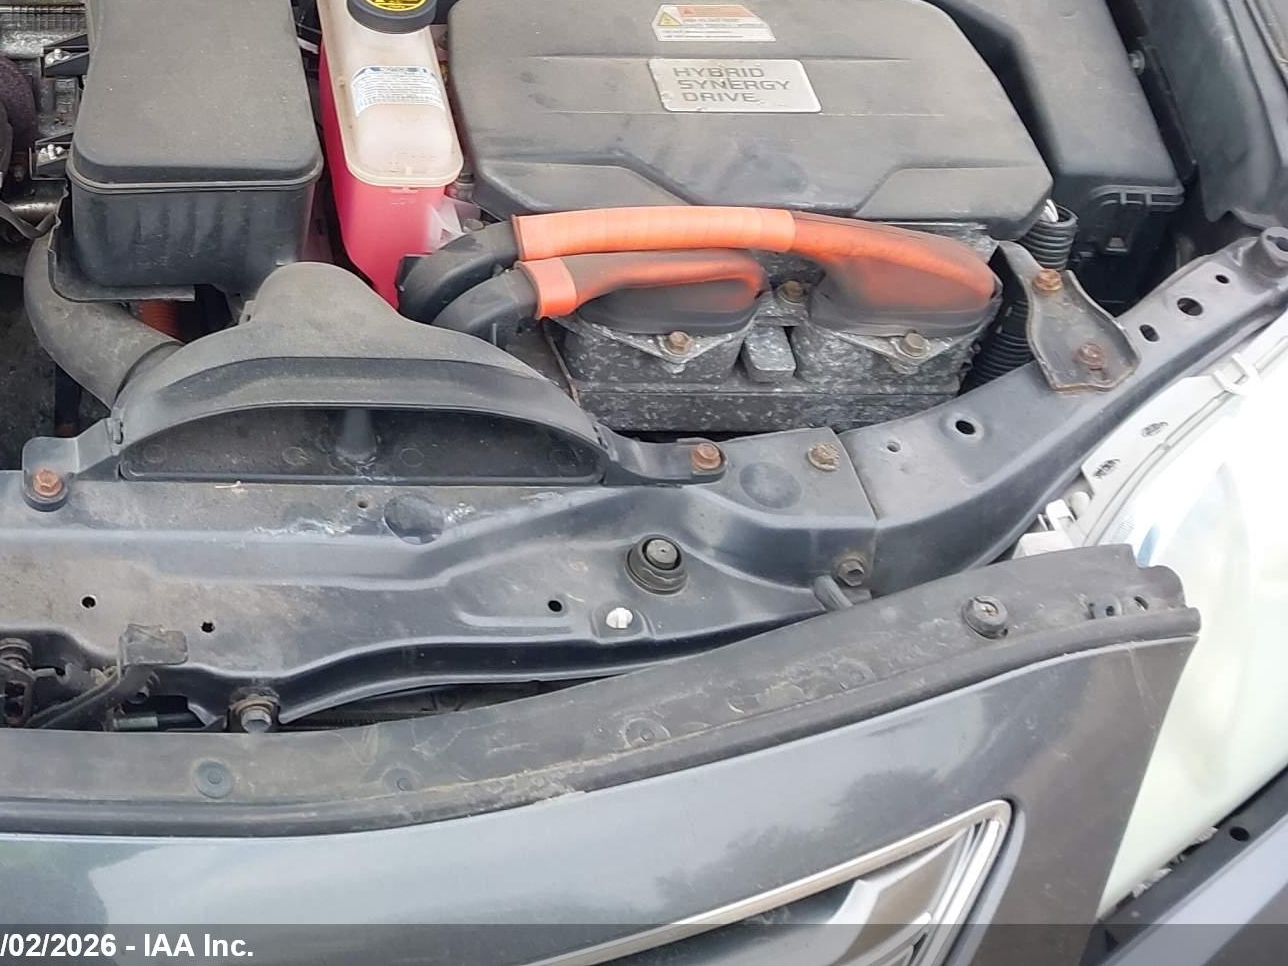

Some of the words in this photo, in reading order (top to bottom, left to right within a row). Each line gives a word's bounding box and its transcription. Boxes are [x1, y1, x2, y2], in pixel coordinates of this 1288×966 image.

[672, 67, 765, 78] HYBRID
[677, 79, 791, 90] SYNERGY
[682, 92, 760, 103] DRIVE
